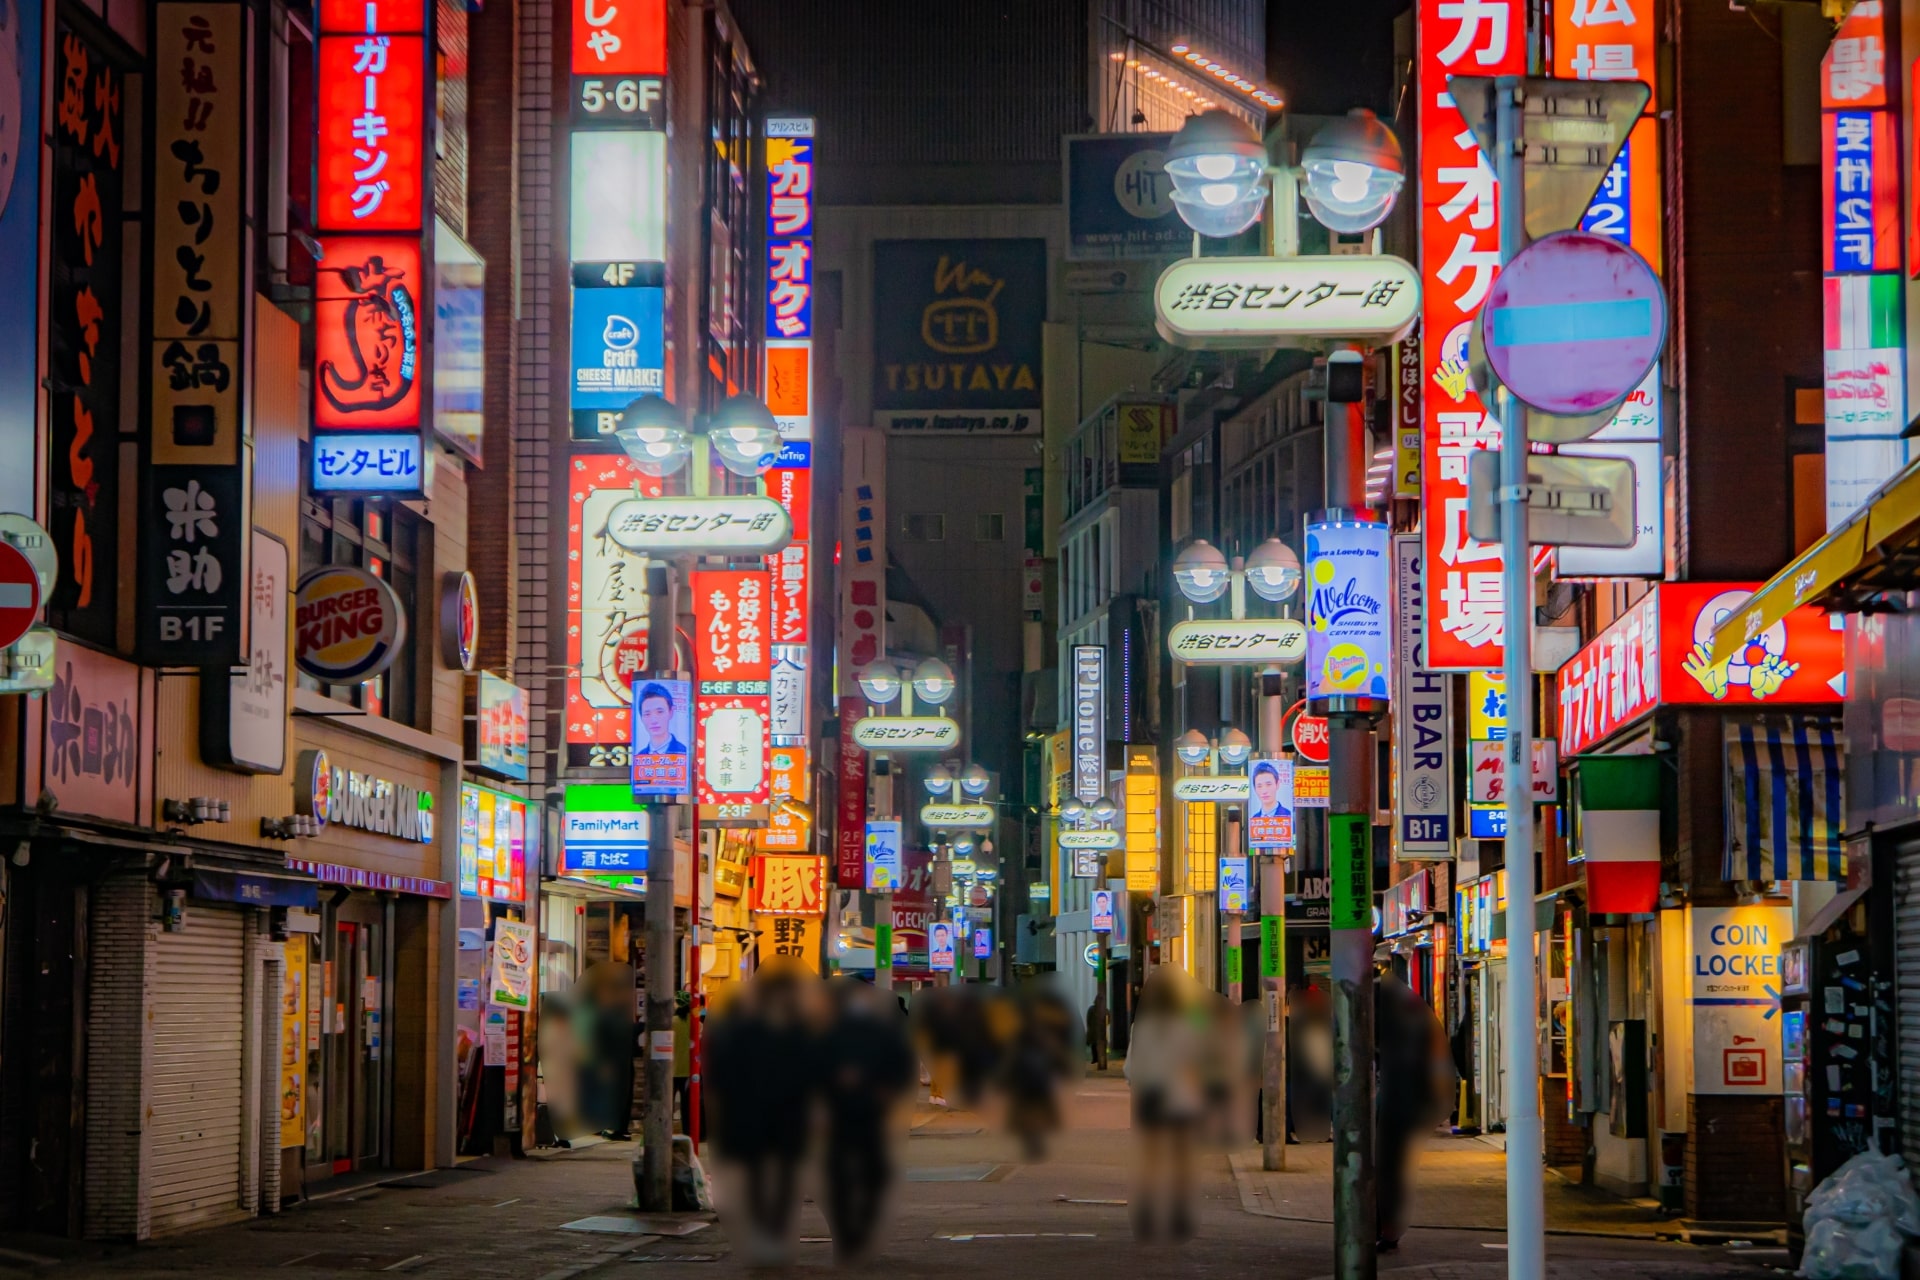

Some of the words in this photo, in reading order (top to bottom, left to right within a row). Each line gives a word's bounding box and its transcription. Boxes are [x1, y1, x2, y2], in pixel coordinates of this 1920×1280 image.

[1436, 2, 1509, 312] カオケ
[770, 158, 810, 316] カラオケ
[602, 263, 635, 286] 4F
[1171, 279, 1405, 310] 渋谷センター街
[603, 349, 638, 368] Craft
[576, 368, 613, 383] CHEESE
[614, 368, 663, 386] MARKET
[886, 363, 1036, 392] TSUTAYA
[317, 448, 418, 476] センタービル
[617, 512, 778, 532] 渋谷センター街
[162, 479, 221, 596] 米助
[1336, 548, 1365, 557] Lovely
[1366, 549, 1380, 558] Day
[296, 588, 380, 627] BURGER
[1310, 577, 1381, 626] Welcome
[159, 617, 224, 643] B1F
[708, 589, 733, 674] もんじゃ
[737, 577, 761, 664] お好み焼
[1337, 620, 1378, 628] SHIBUYA
[296, 607, 384, 657] KING
[1177, 632, 1301, 649] 渋谷センター街
[736, 682, 768, 694] 85席
[736, 714, 750, 771] ケーキと
[860, 727, 951, 739] 渋谷センター街
[1299, 722, 1329, 744] 消火
[1412, 703, 1442, 770] BAR
[719, 742, 733, 787] お食事
[1179, 784, 1248, 794] 渋谷センター街
[331, 764, 395, 836] BURGER
[396, 783, 434, 845] KING
[926, 811, 988, 820] 渋谷センター街
[571, 819, 639, 833] FamilyMart
[842, 831, 860, 842] 2F
[1409, 819, 1442, 839] B1F
[581, 851, 596, 866] 酒
[600, 852, 629, 865] たばこ
[842, 849, 860, 860] 3F
[760, 857, 817, 909] 豚
[842, 866, 860, 878] 4F
[1307, 907, 1331, 917] GRAN
[1710, 924, 1768, 946] COIN
[1695, 954, 1782, 976] LOCKE
